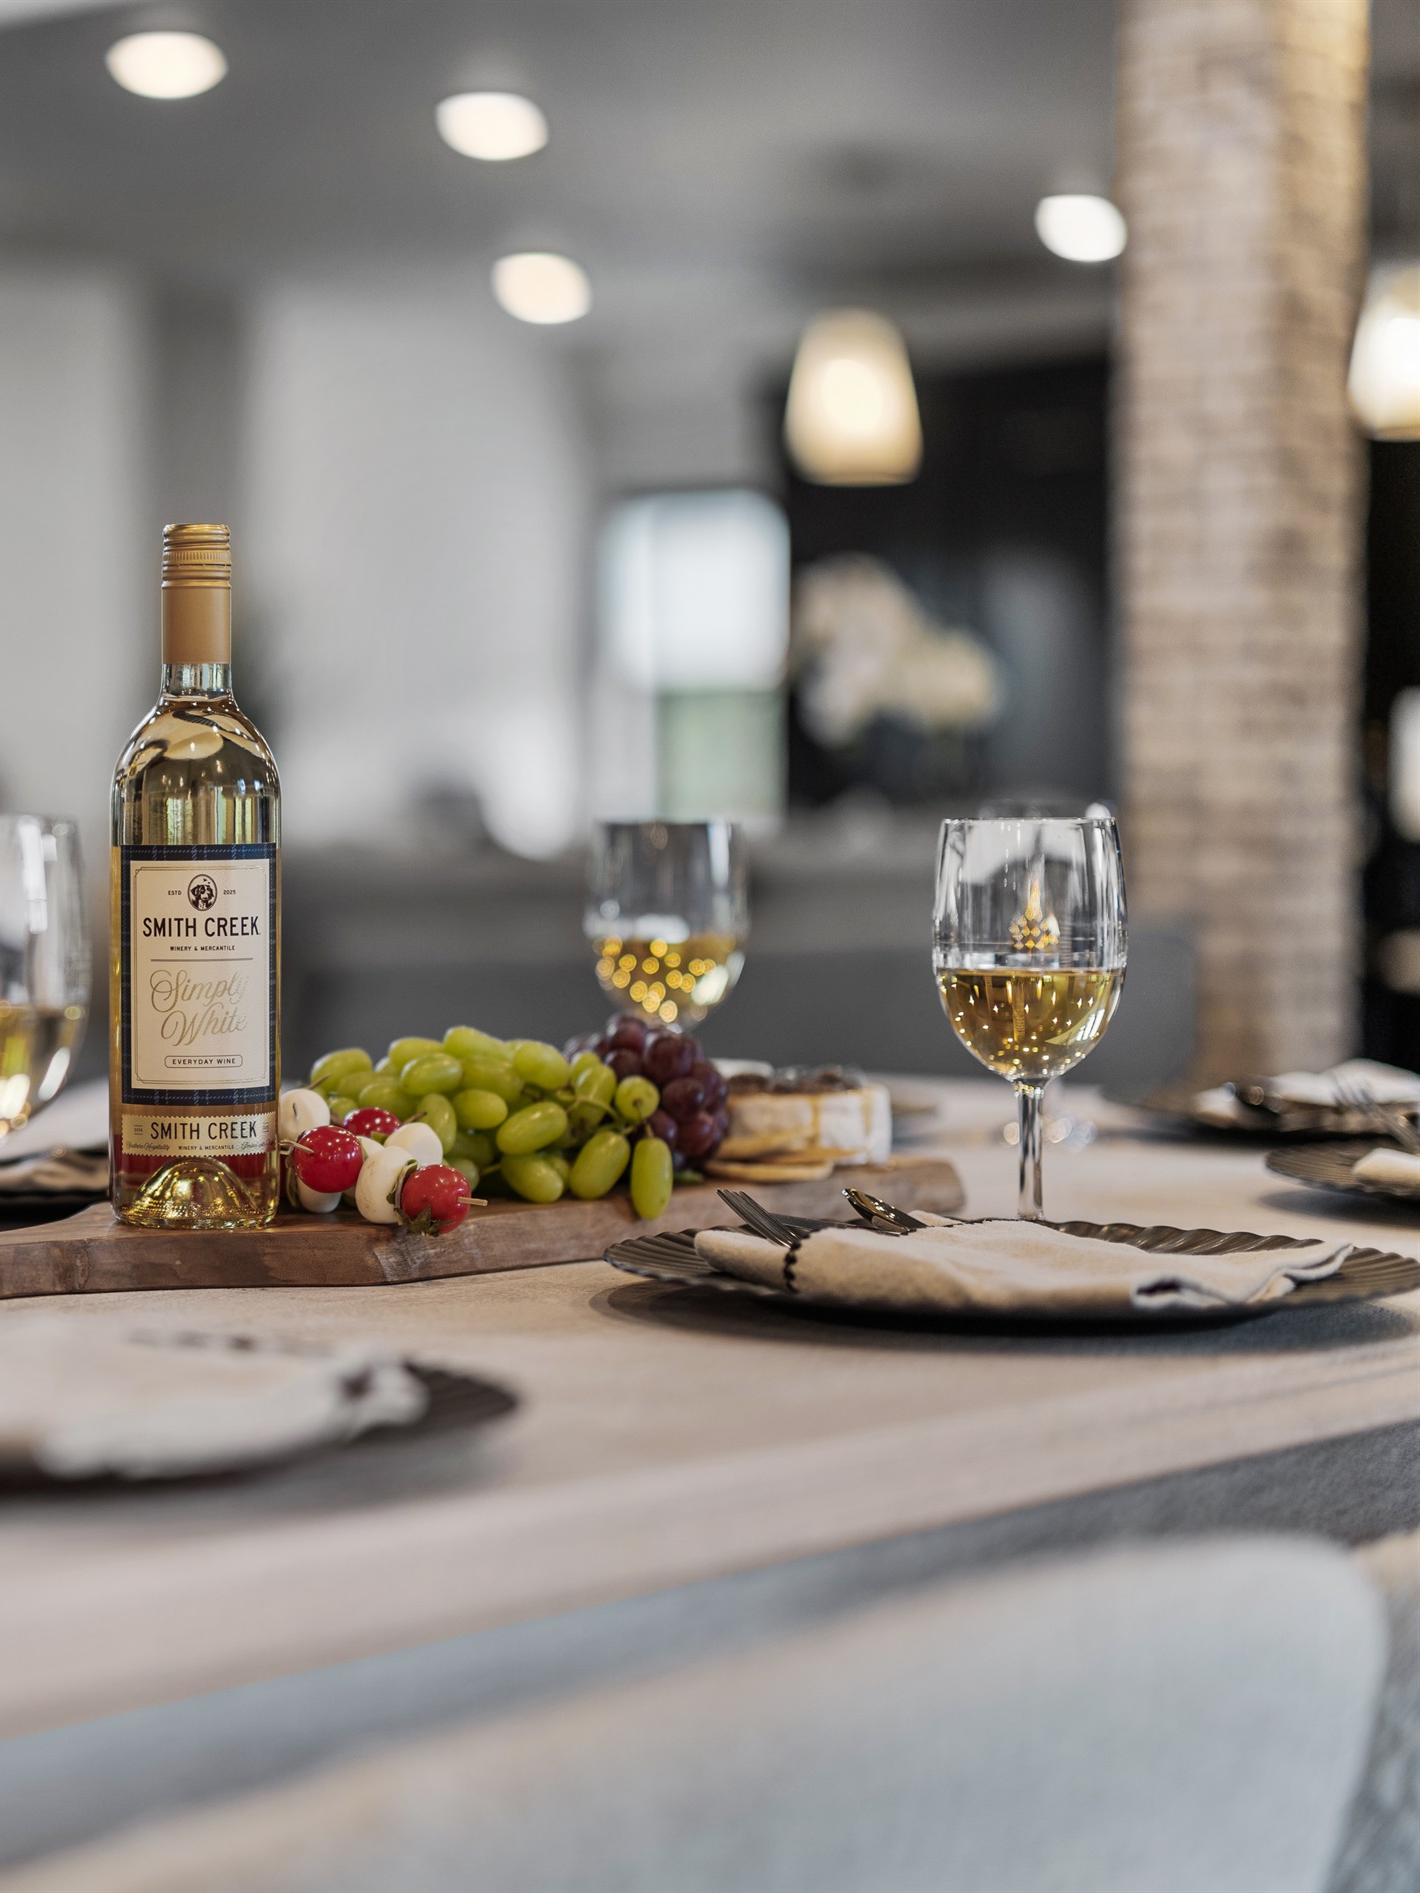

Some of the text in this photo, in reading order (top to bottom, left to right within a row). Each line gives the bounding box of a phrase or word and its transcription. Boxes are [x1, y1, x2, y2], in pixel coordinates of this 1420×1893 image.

[142, 916, 259, 937] SMITH CREEK
[150, 970, 249, 1012] Simply
[161, 1002, 247, 1046] White
[150, 1121, 257, 1140] SMITH CREEK
